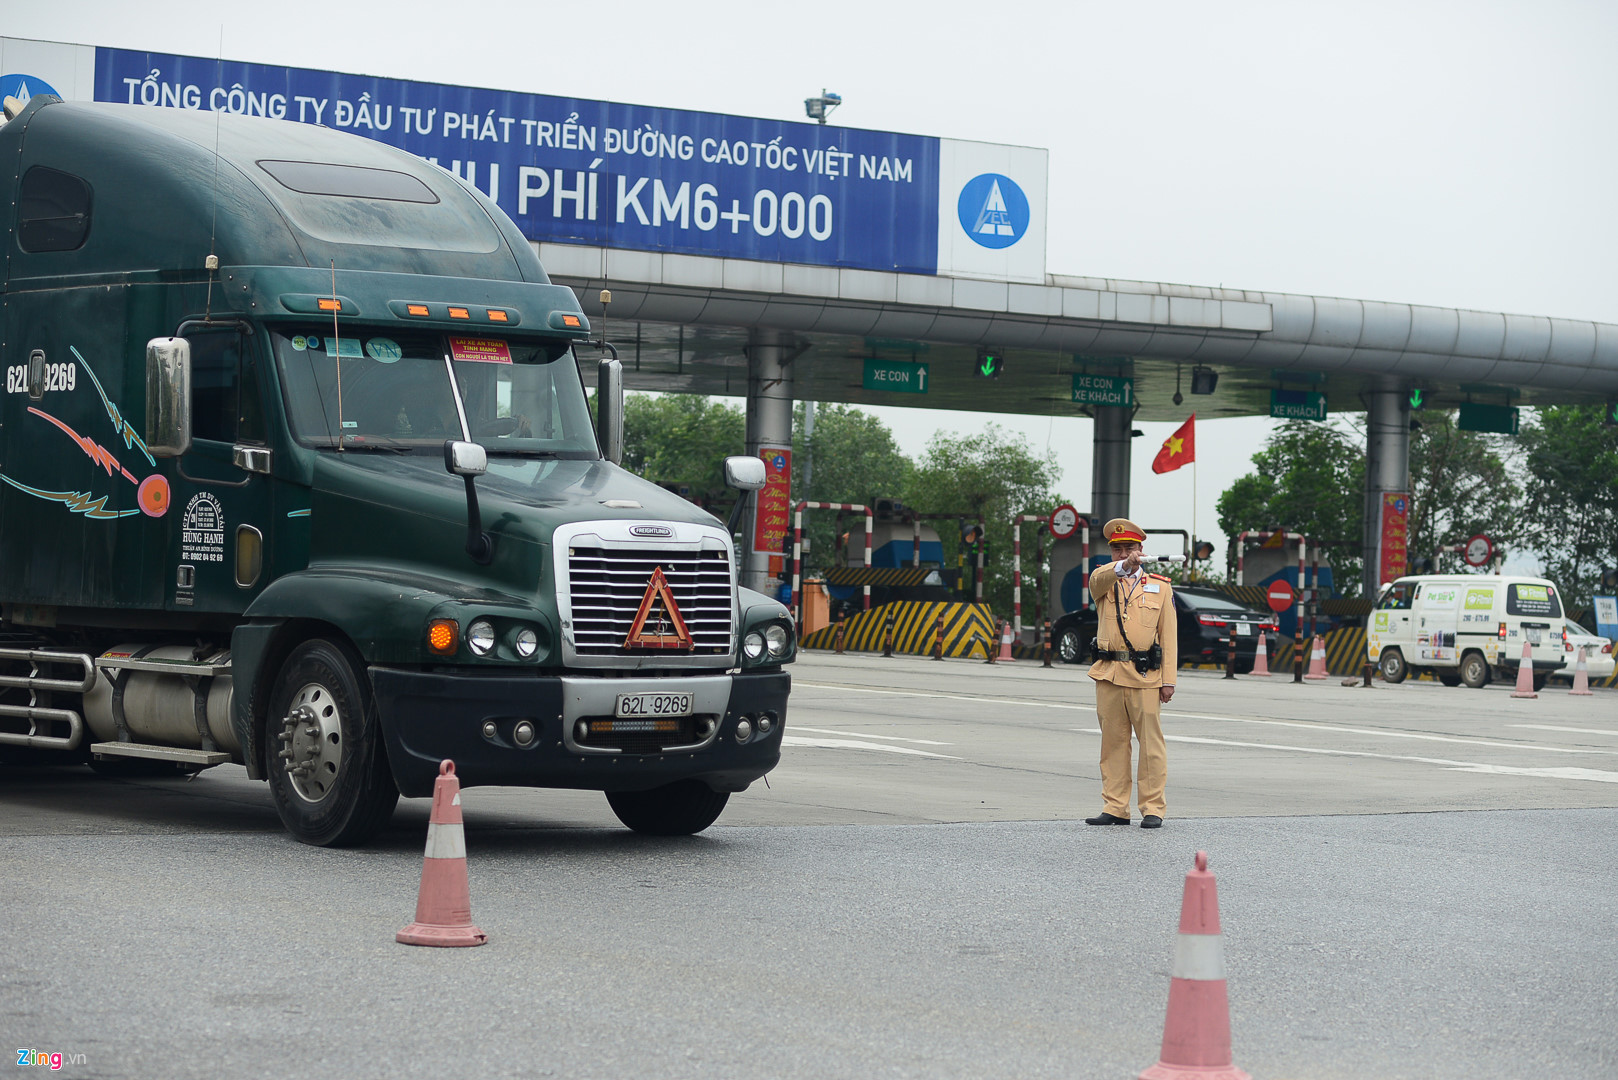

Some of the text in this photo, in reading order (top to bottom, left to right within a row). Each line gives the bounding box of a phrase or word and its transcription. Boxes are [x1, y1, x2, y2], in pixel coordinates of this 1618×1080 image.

[122, 68, 202, 110] TỔNG
[209, 83, 287, 120] CÔNG
[294, 95, 329, 125] TY
[334, 92, 393, 132] ĐẦU
[400, 107, 437, 135] TƯ
[443, 109, 516, 143] PHÁT
[521, 112, 597, 152] TRIỂN
[603, 124, 694, 161] ĐƯỜNG
[802, 145, 854, 181] VIỆT
[859, 154, 913, 183] NAM
[518, 158, 604, 222] PHÍ
[615, 174, 833, 242] KM6+000
[44, 362, 76, 392] 9269
[873, 368, 910, 383] XE CON
[1079, 376, 1113, 390] XE CON
[1074, 389, 1121, 404] XE KHÁCH
[1273, 403, 1318, 418] XE KHÁCH
